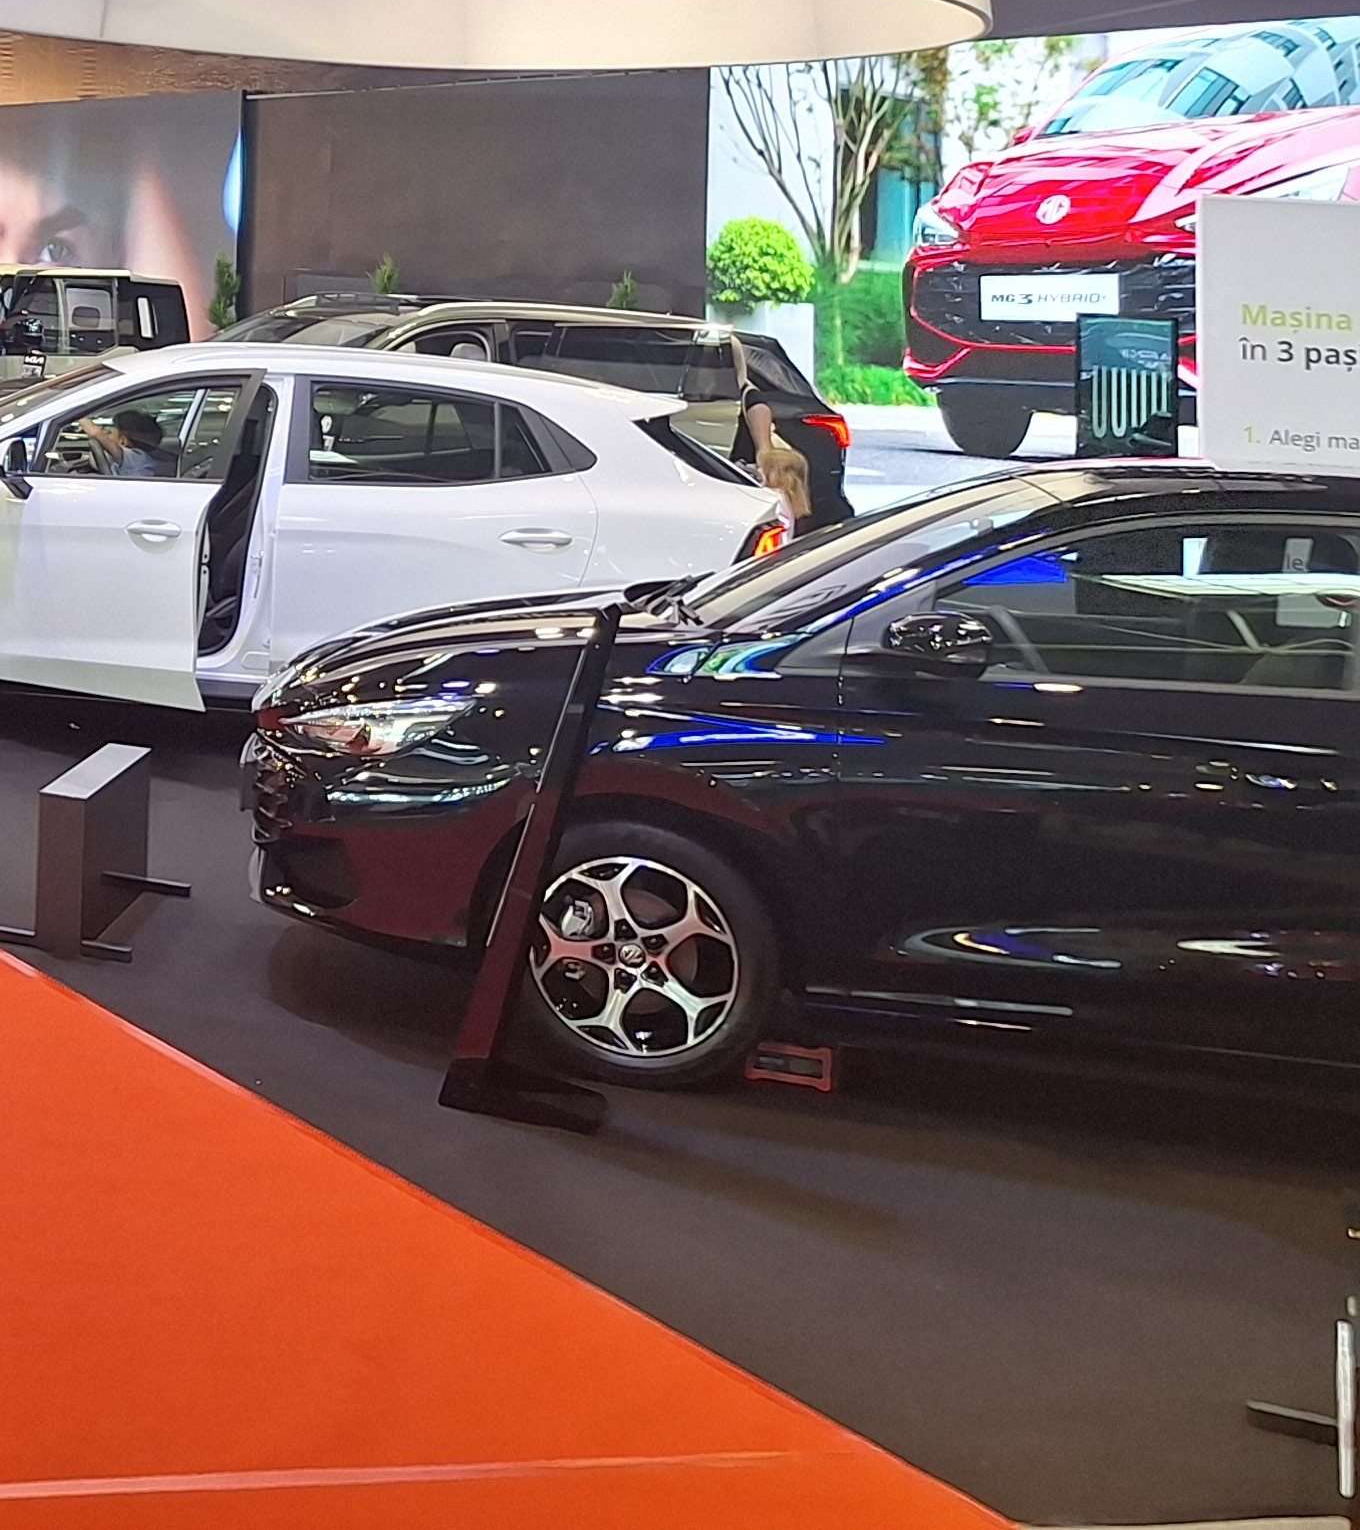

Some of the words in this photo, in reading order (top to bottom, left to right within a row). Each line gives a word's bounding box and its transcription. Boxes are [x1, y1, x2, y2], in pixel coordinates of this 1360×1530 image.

[1241, 303, 1353, 334] Mașina
[1238, 337, 1267, 361] în
[1277, 341, 1294, 362] 3
[1305, 345, 1360, 372] paș
[1243, 425, 1261, 444] 1.
[1269, 429, 1321, 452] Alegi
